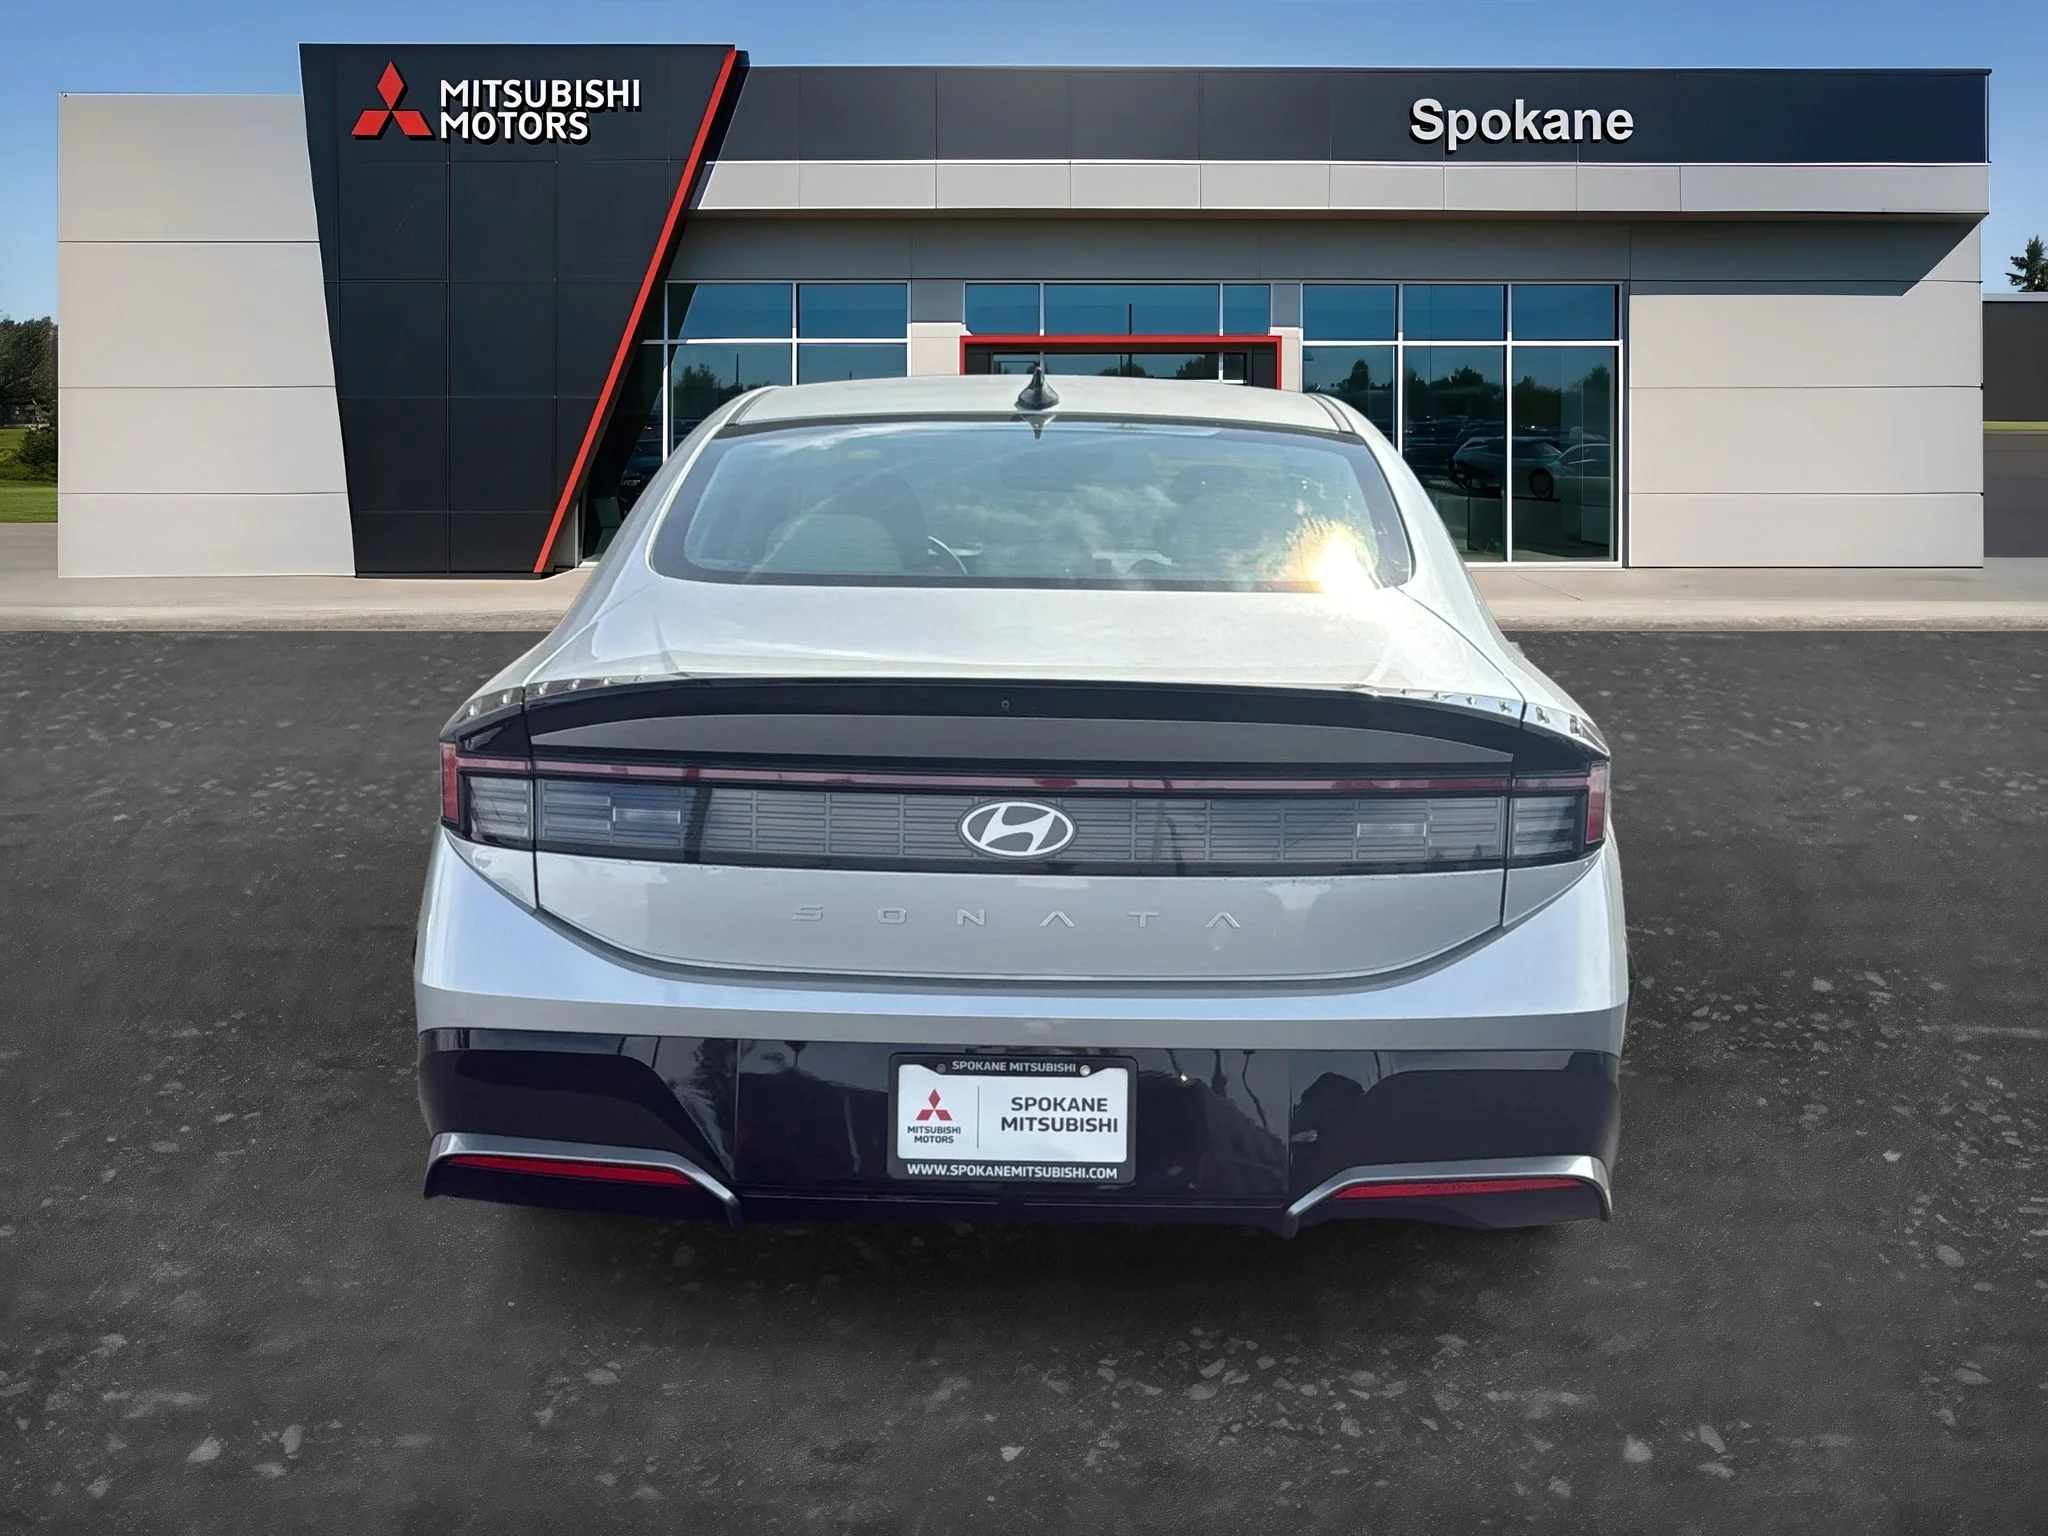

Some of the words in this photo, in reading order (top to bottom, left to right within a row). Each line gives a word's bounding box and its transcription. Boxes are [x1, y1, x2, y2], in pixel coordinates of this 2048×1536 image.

[440, 79, 641, 108] MITSUBISHI
[440, 111, 589, 140] MOTORS
[1410, 98, 1635, 151] Spokane
[792, 905, 1241, 929] SONATA
[951, 1060, 1007, 1072] SPOKANE
[1009, 1062, 1077, 1073] MITSUBISHI
[1010, 1096, 1108, 1112] SPOKANE
[907, 1125, 962, 1135] MITSUBISHI
[1000, 1117, 1118, 1133] MITSUBISHI
[914, 1135, 954, 1144] MOTORS
[906, 1163, 1118, 1180] WWW.SPOKANEMITSUBISHI.COM
